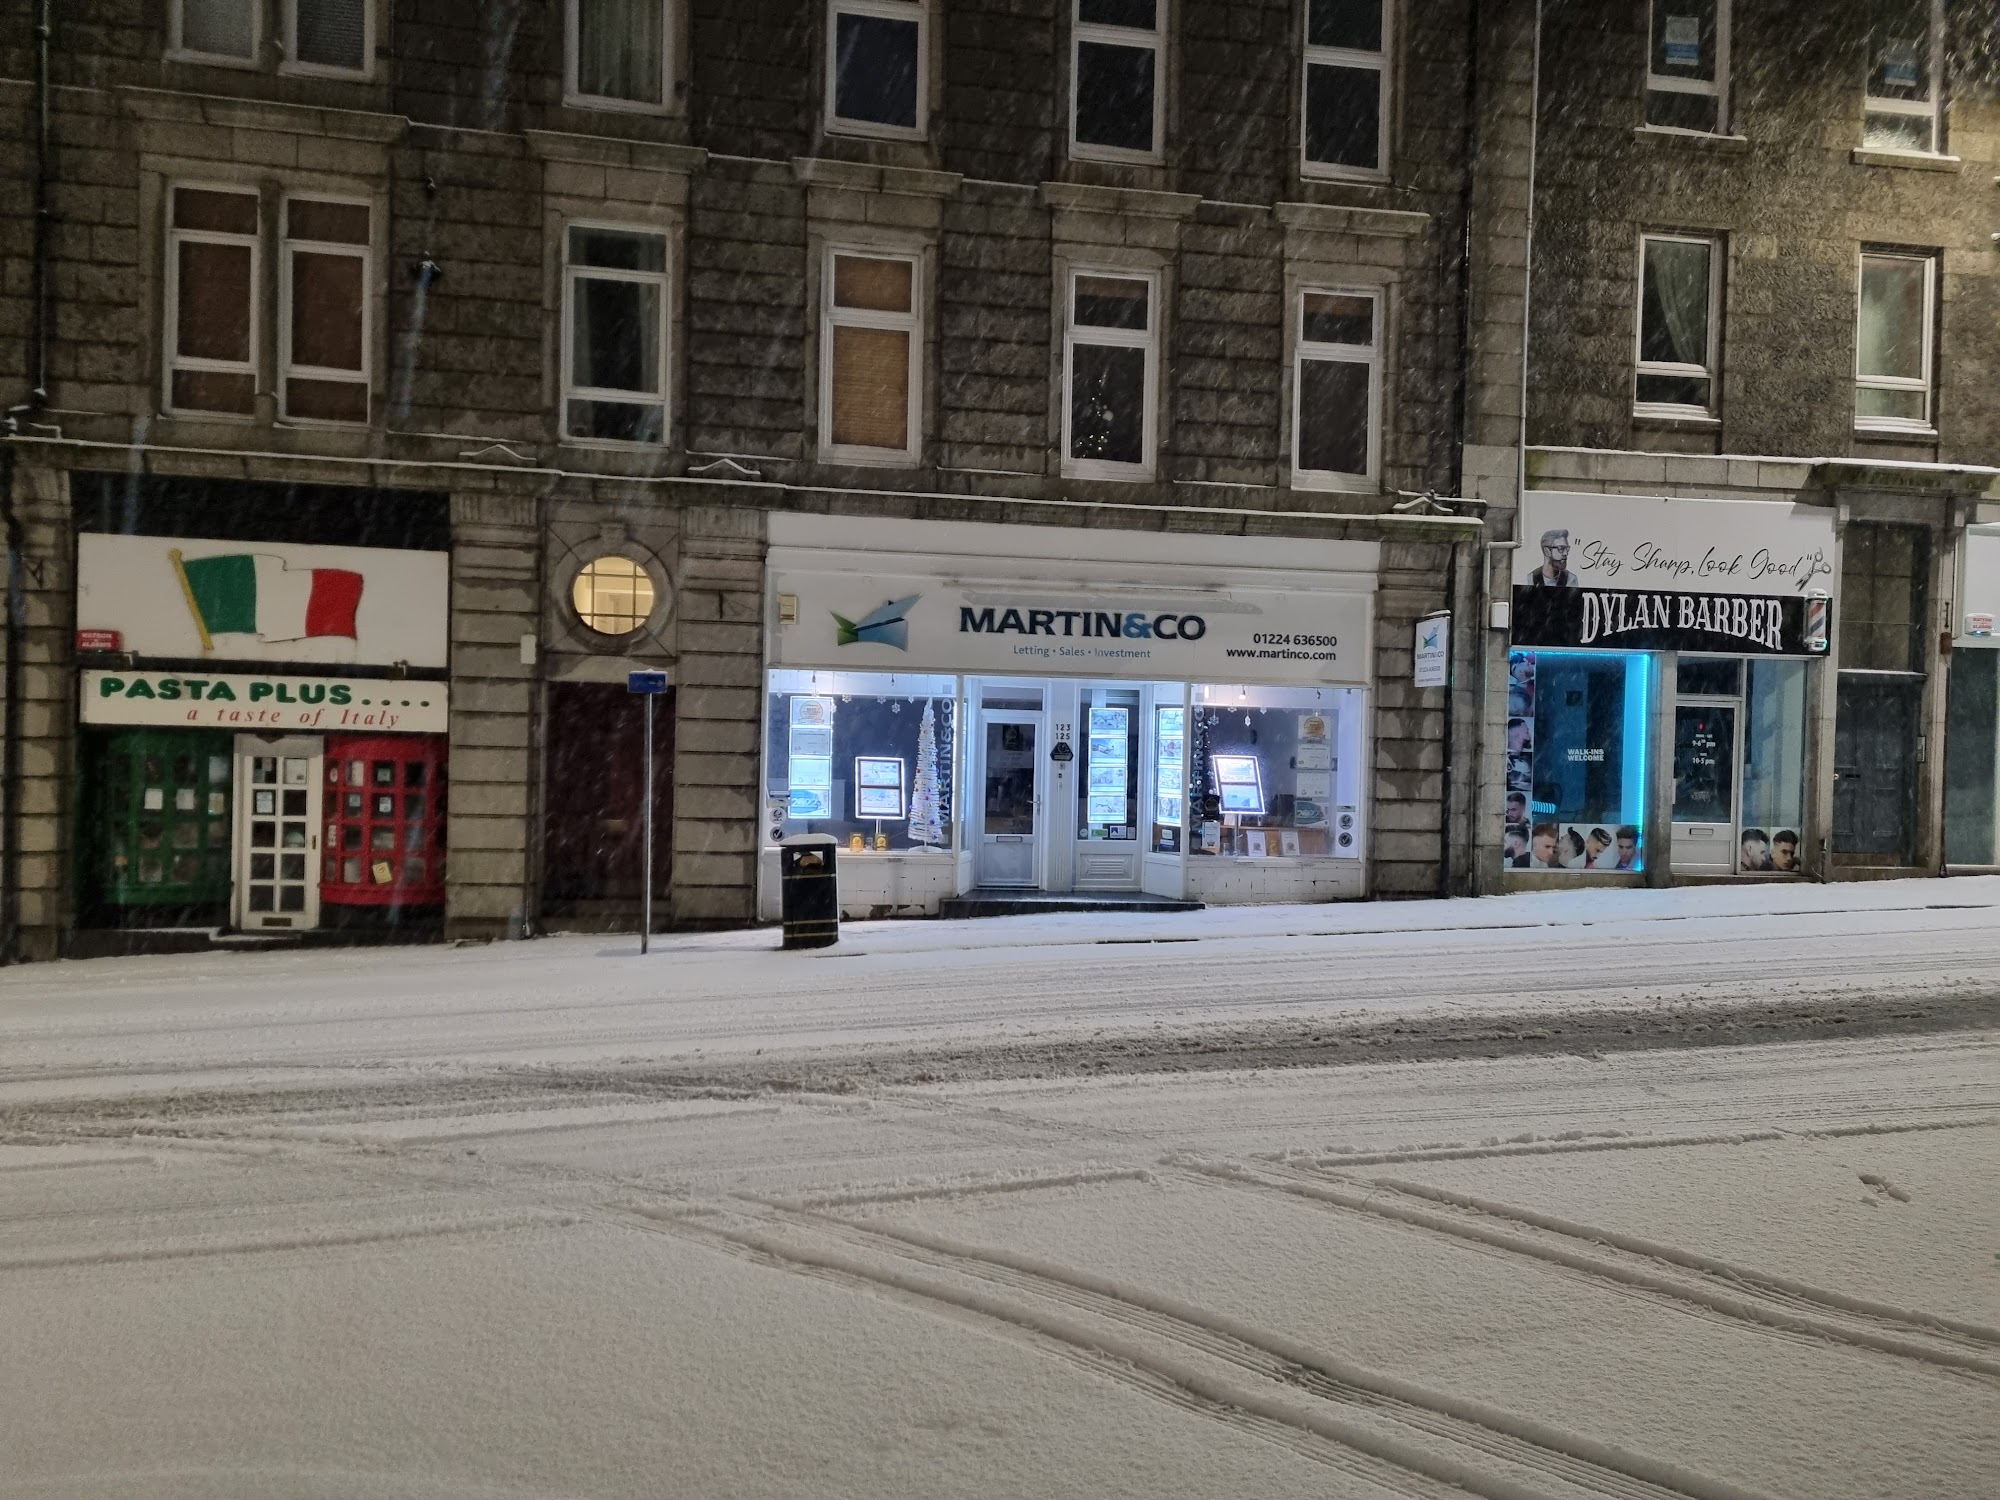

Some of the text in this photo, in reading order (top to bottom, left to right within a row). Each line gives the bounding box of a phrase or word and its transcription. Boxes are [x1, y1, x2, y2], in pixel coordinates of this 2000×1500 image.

[1698, 546, 1743, 577] Look
[959, 606, 1207, 641] MARTIN&CO
[1580, 592, 1783, 651] DYLAN BARBER
[1253, 633, 1338, 647] 01224 636500
[1013, 645, 1151, 659] Letting Sales Investment
[1226, 648, 1337, 661] www.martinco.com
[100, 677, 237, 701] PASTA
[186, 708, 400, 729] a taste of Italy
[1055, 723, 1071, 732] 123
[1055, 732, 1071, 740] 125
[1567, 754, 1604, 762] WELCOME
